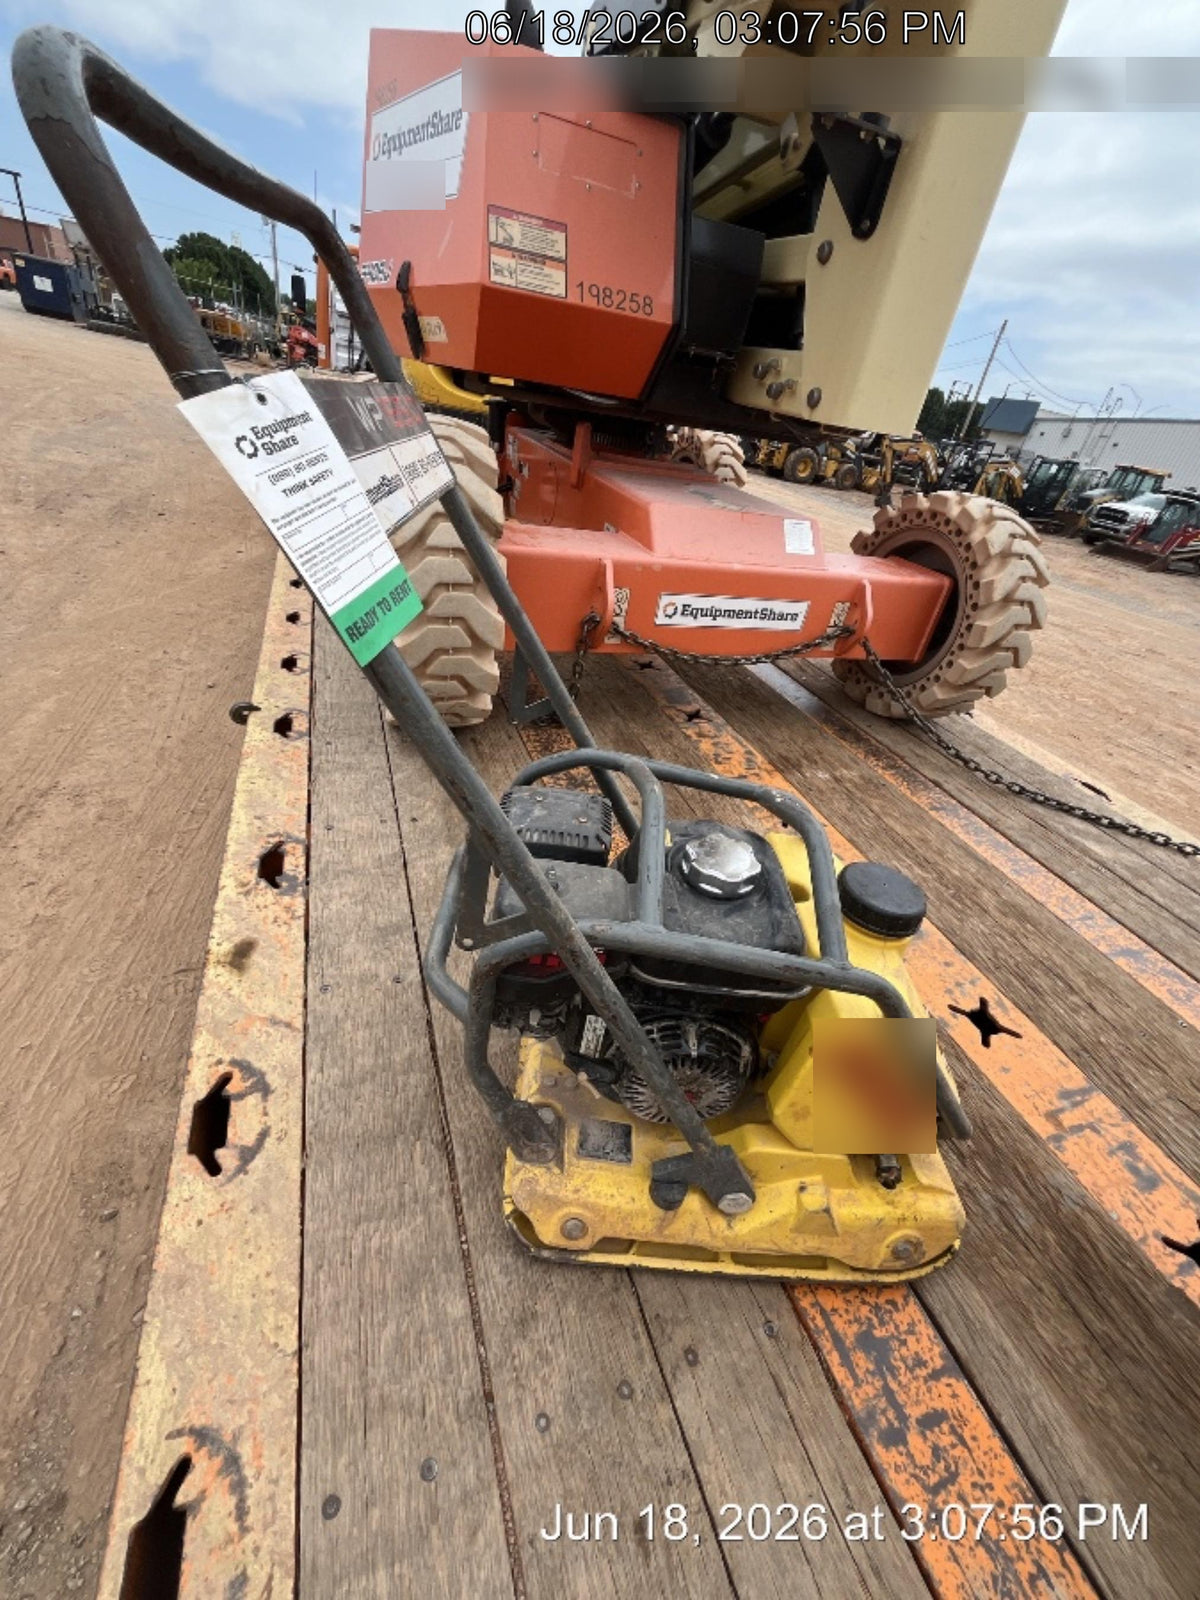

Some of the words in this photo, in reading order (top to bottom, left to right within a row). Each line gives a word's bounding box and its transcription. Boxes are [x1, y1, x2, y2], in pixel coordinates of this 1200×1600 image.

[577, 281, 653, 316] 198258
[249, 411, 313, 440] Equipment
[261, 434, 299, 455] Share
[344, 611, 379, 644] READY
[378, 596, 393, 617] TO
[389, 578, 413, 606] RENT
[680, 603, 800, 622] EquipmentShare
